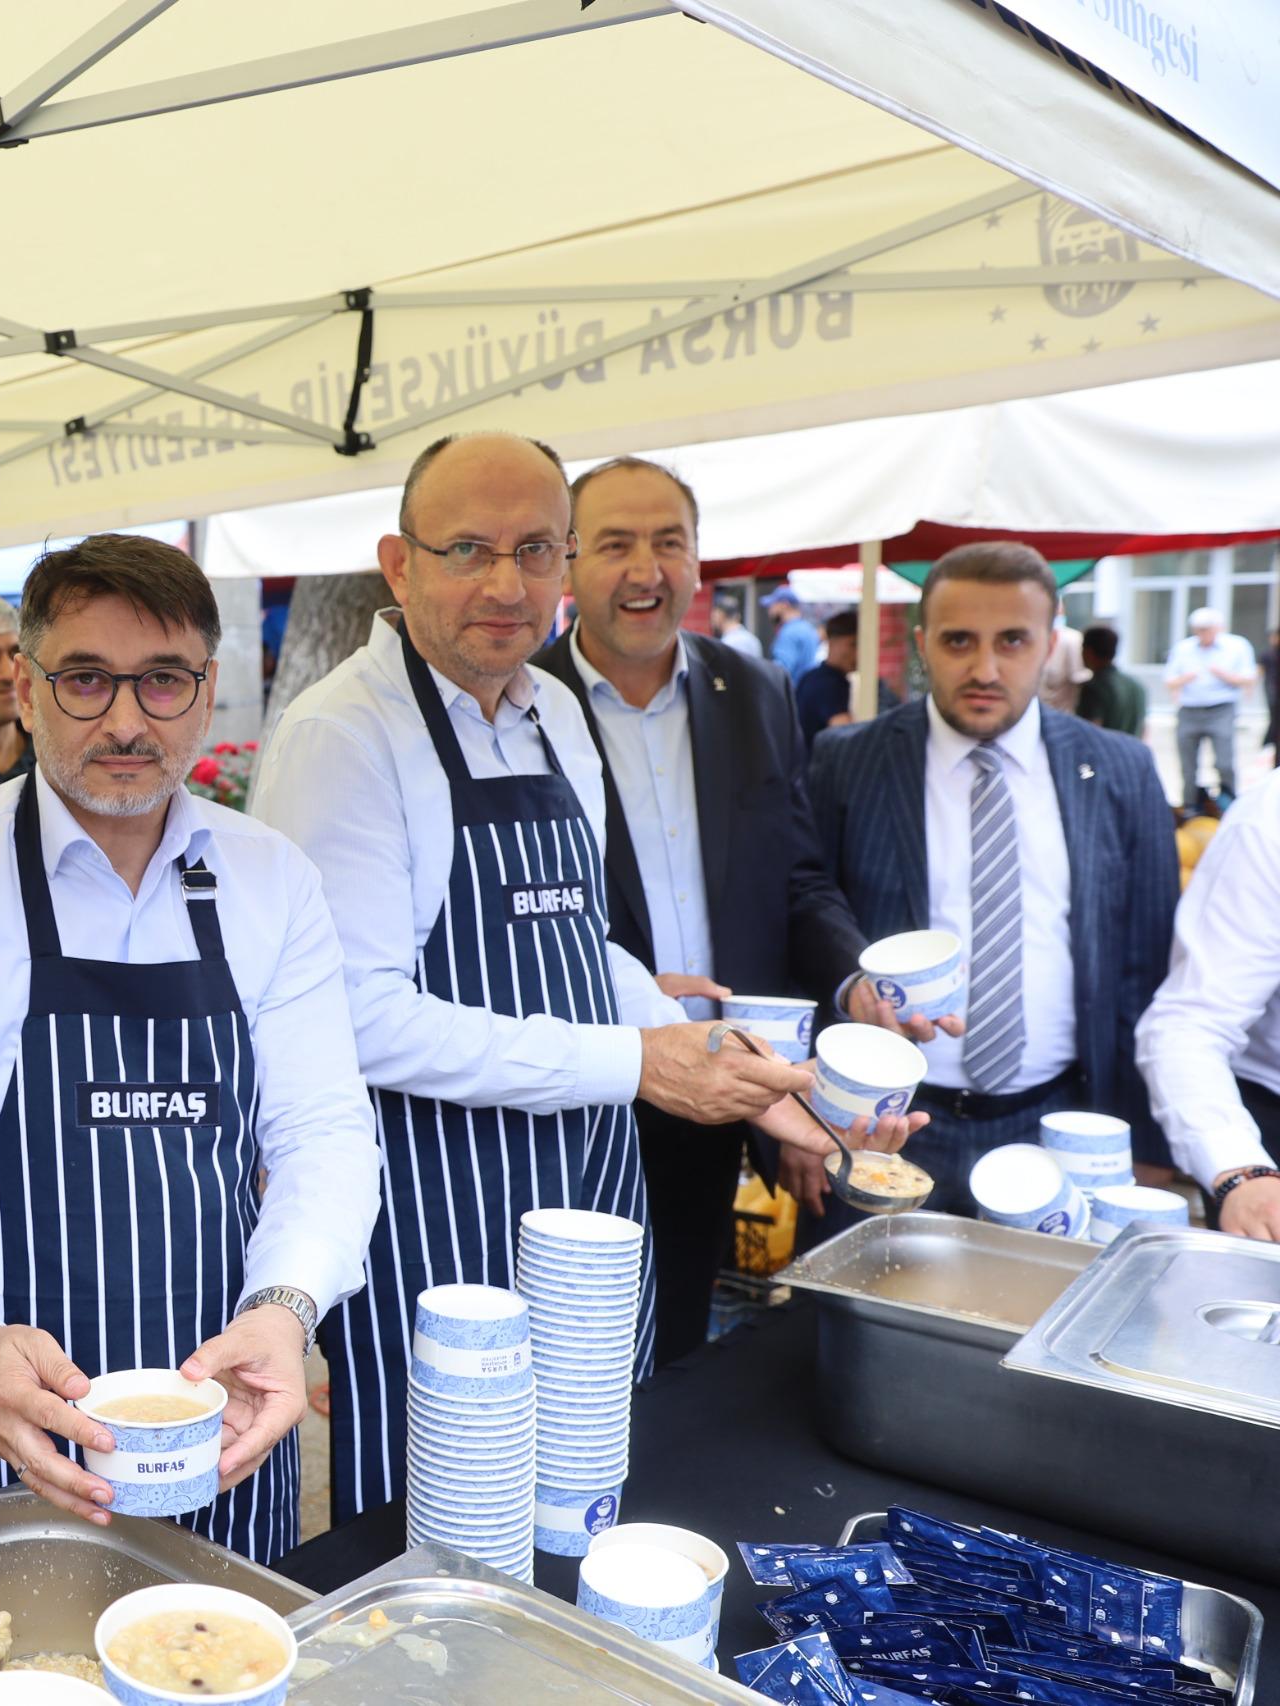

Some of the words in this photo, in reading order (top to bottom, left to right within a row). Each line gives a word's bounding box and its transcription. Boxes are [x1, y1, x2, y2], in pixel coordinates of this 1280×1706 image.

[513, 887, 584, 915] BURFAŞ
[91, 1091, 207, 1124] BURFAŞ
[137, 1459, 185, 1473] BURFAŞ
